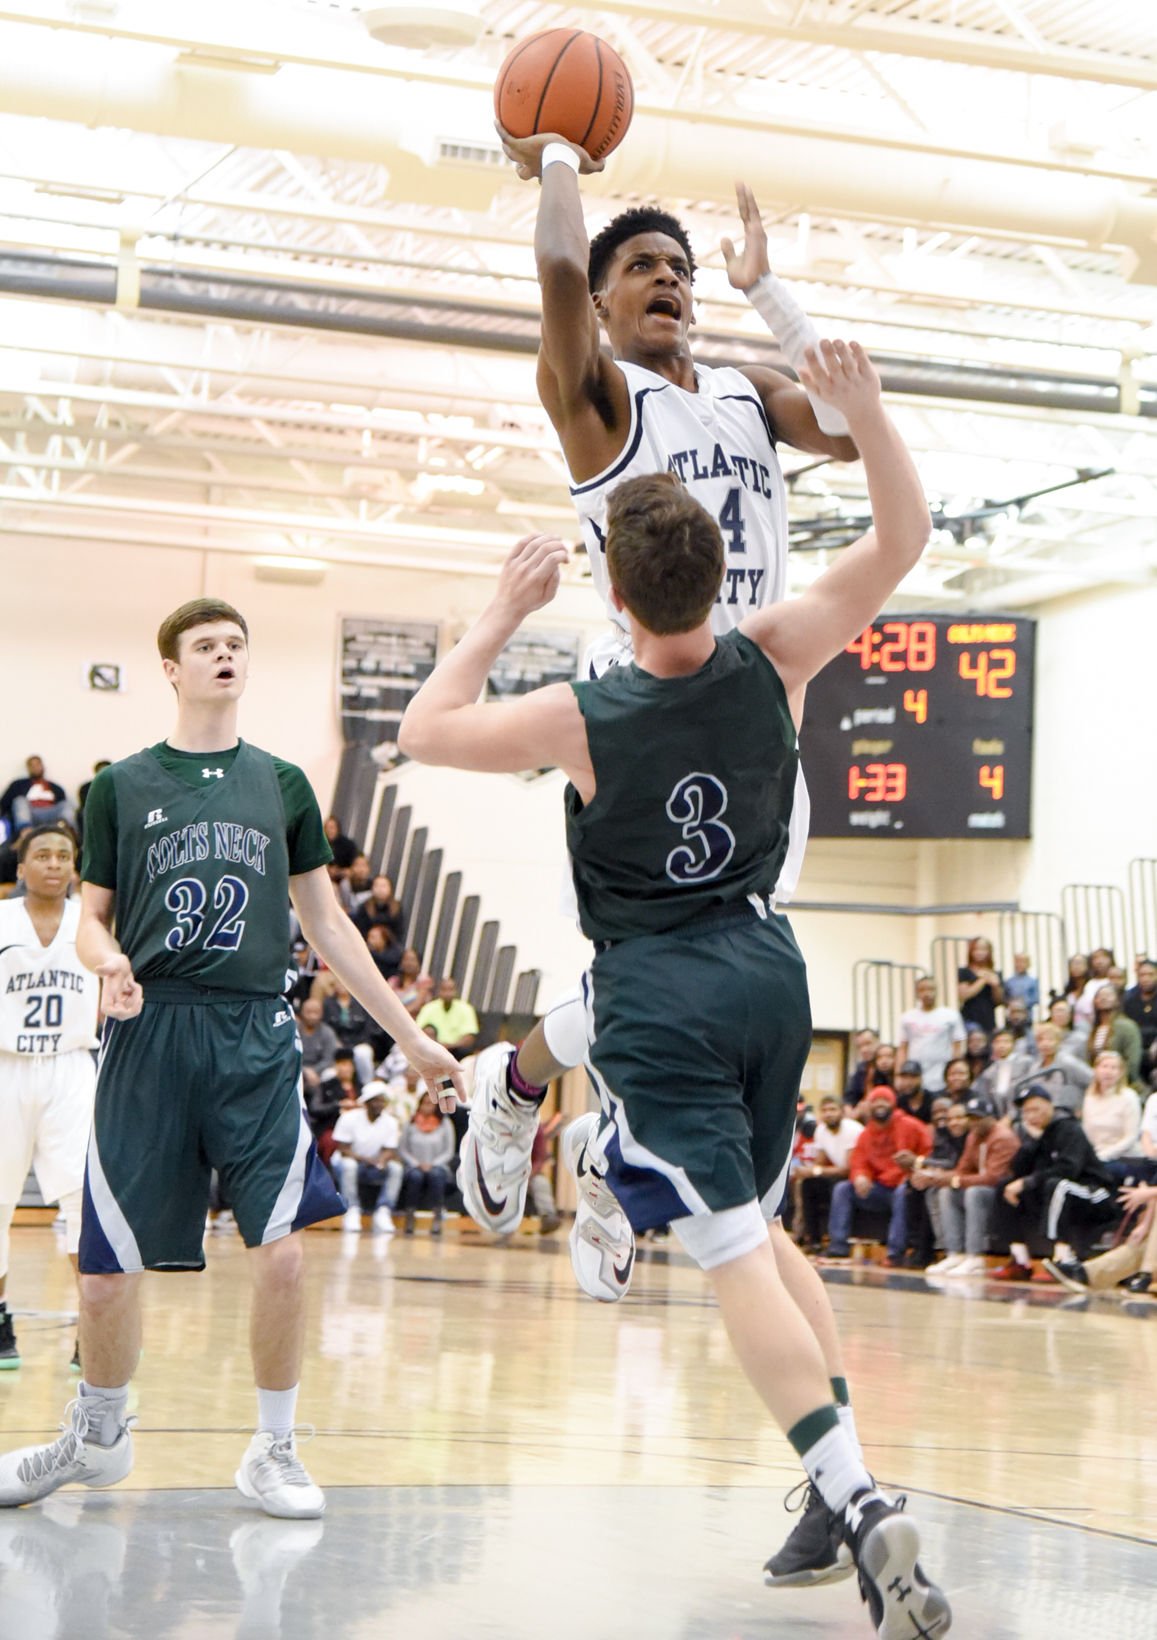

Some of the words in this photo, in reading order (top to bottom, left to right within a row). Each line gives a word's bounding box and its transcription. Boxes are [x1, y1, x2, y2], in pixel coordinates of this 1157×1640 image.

[667, 443, 772, 500] ATLATIC
[719, 487, 747, 553] 4
[715, 569, 764, 605] TY
[846, 622, 937, 672] 4:28
[958, 649, 1017, 698] 42
[903, 689, 928, 724] 4
[979, 764, 1005, 800] 4
[146, 822, 210, 883] COLTS
[213, 821, 271, 876] NECK
[666, 771, 736, 884] 3
[165, 874, 249, 952] 32
[5, 969, 85, 994] ATLANTIC
[24, 994, 63, 1028] 20
[16, 1033, 62, 1053] CITY
